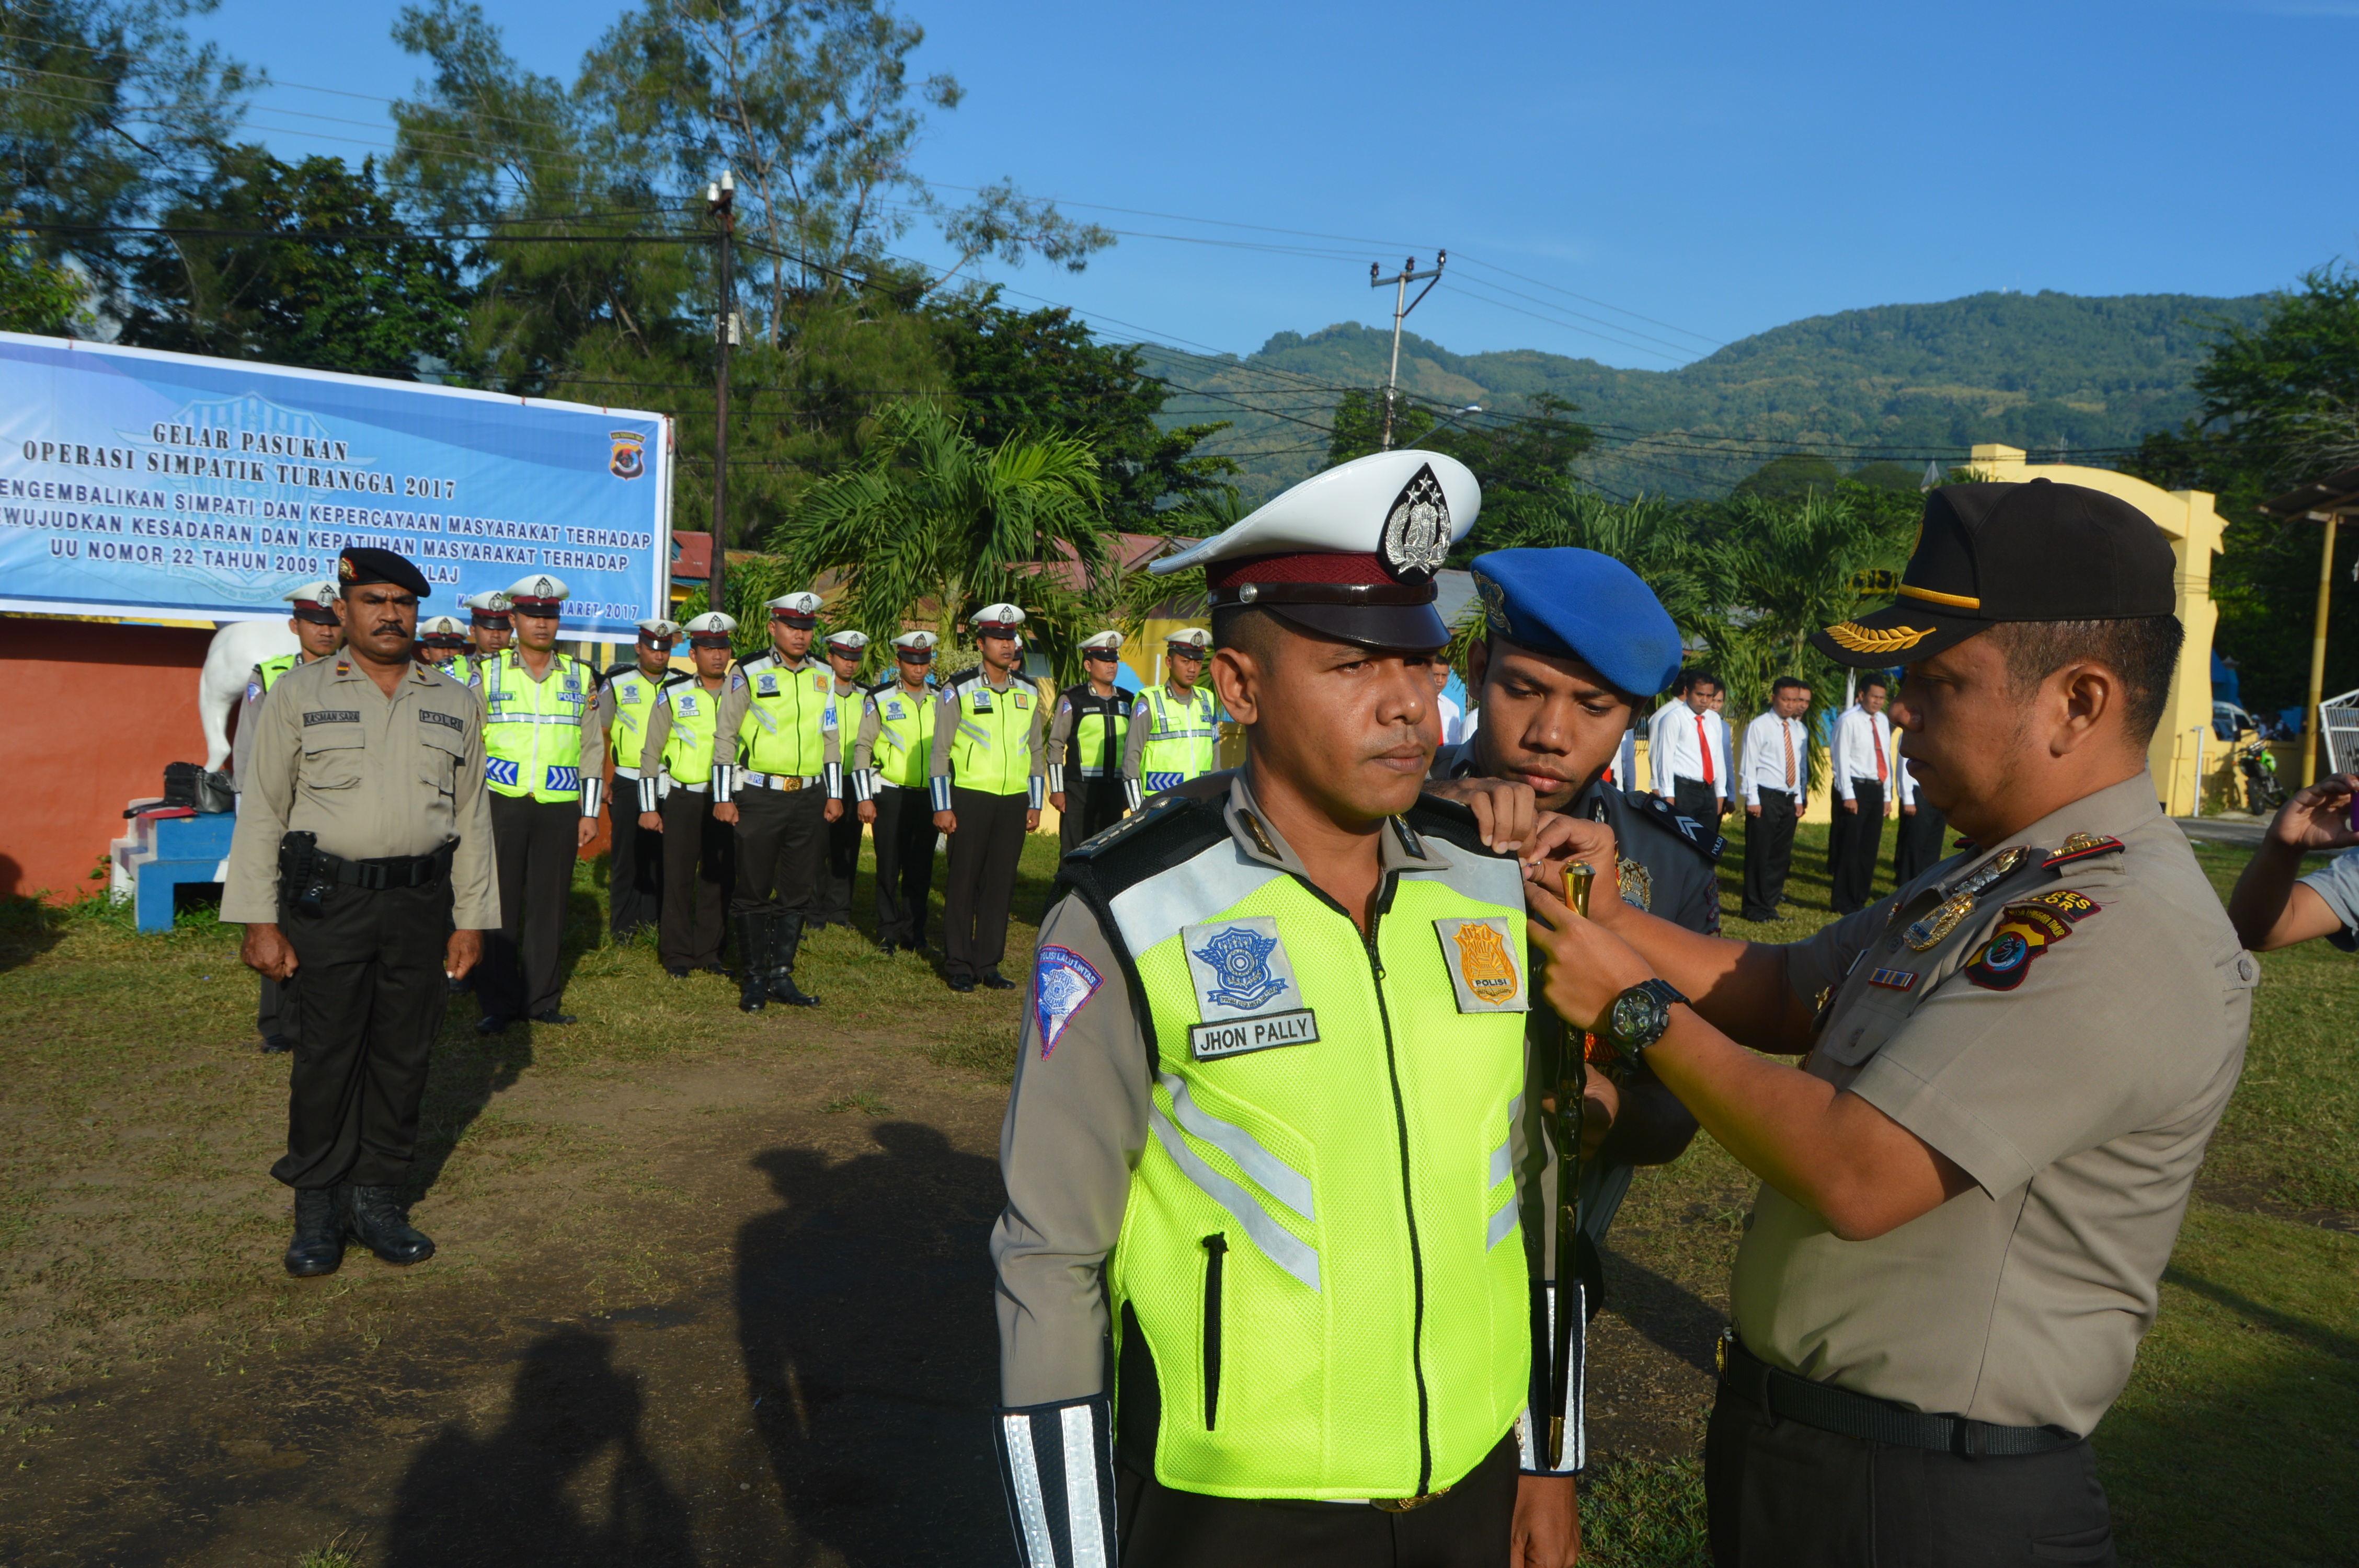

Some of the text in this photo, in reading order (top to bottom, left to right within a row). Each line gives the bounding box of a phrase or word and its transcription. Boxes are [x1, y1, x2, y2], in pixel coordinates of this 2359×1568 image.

[153, 423, 347, 461] GELAR PASUKAN
[24, 440, 454, 500] OPERASI SIMPATIK TURANGGA 2017
[175, 493, 254, 516] SIMPATI
[264, 501, 300, 520] DAN
[310, 505, 440, 532] KEPERCAYAAN
[449, 518, 558, 541] MASYARAKAT
[567, 527, 651, 549] TERHADAP
[0, 507, 628, 571] WUJUDKAN KESADARAN DAN KEPATUHAN MASYARAKAT TERHADAP
[51, 538, 78, 557] UU
[88, 541, 163, 563] NOMOR
[173, 548, 193, 564] 22
[203, 550, 266, 570] TAHUN
[276, 556, 317, 573] 2009
[418, 566, 458, 583] LAJ
[606, 603, 638, 619] 2017
[557, 693, 585, 704] POLISI
[305, 711, 359, 724] KASMAN SARA
[422, 712, 462, 729] POLRI
[1711, 836, 1724, 855] POLISI
[2047, 918, 2066, 938] TIMUR
[1039, 951, 1096, 985] POLISI LALU LINTAS
[1200, 1018, 1307, 1051] JHON PALLY
